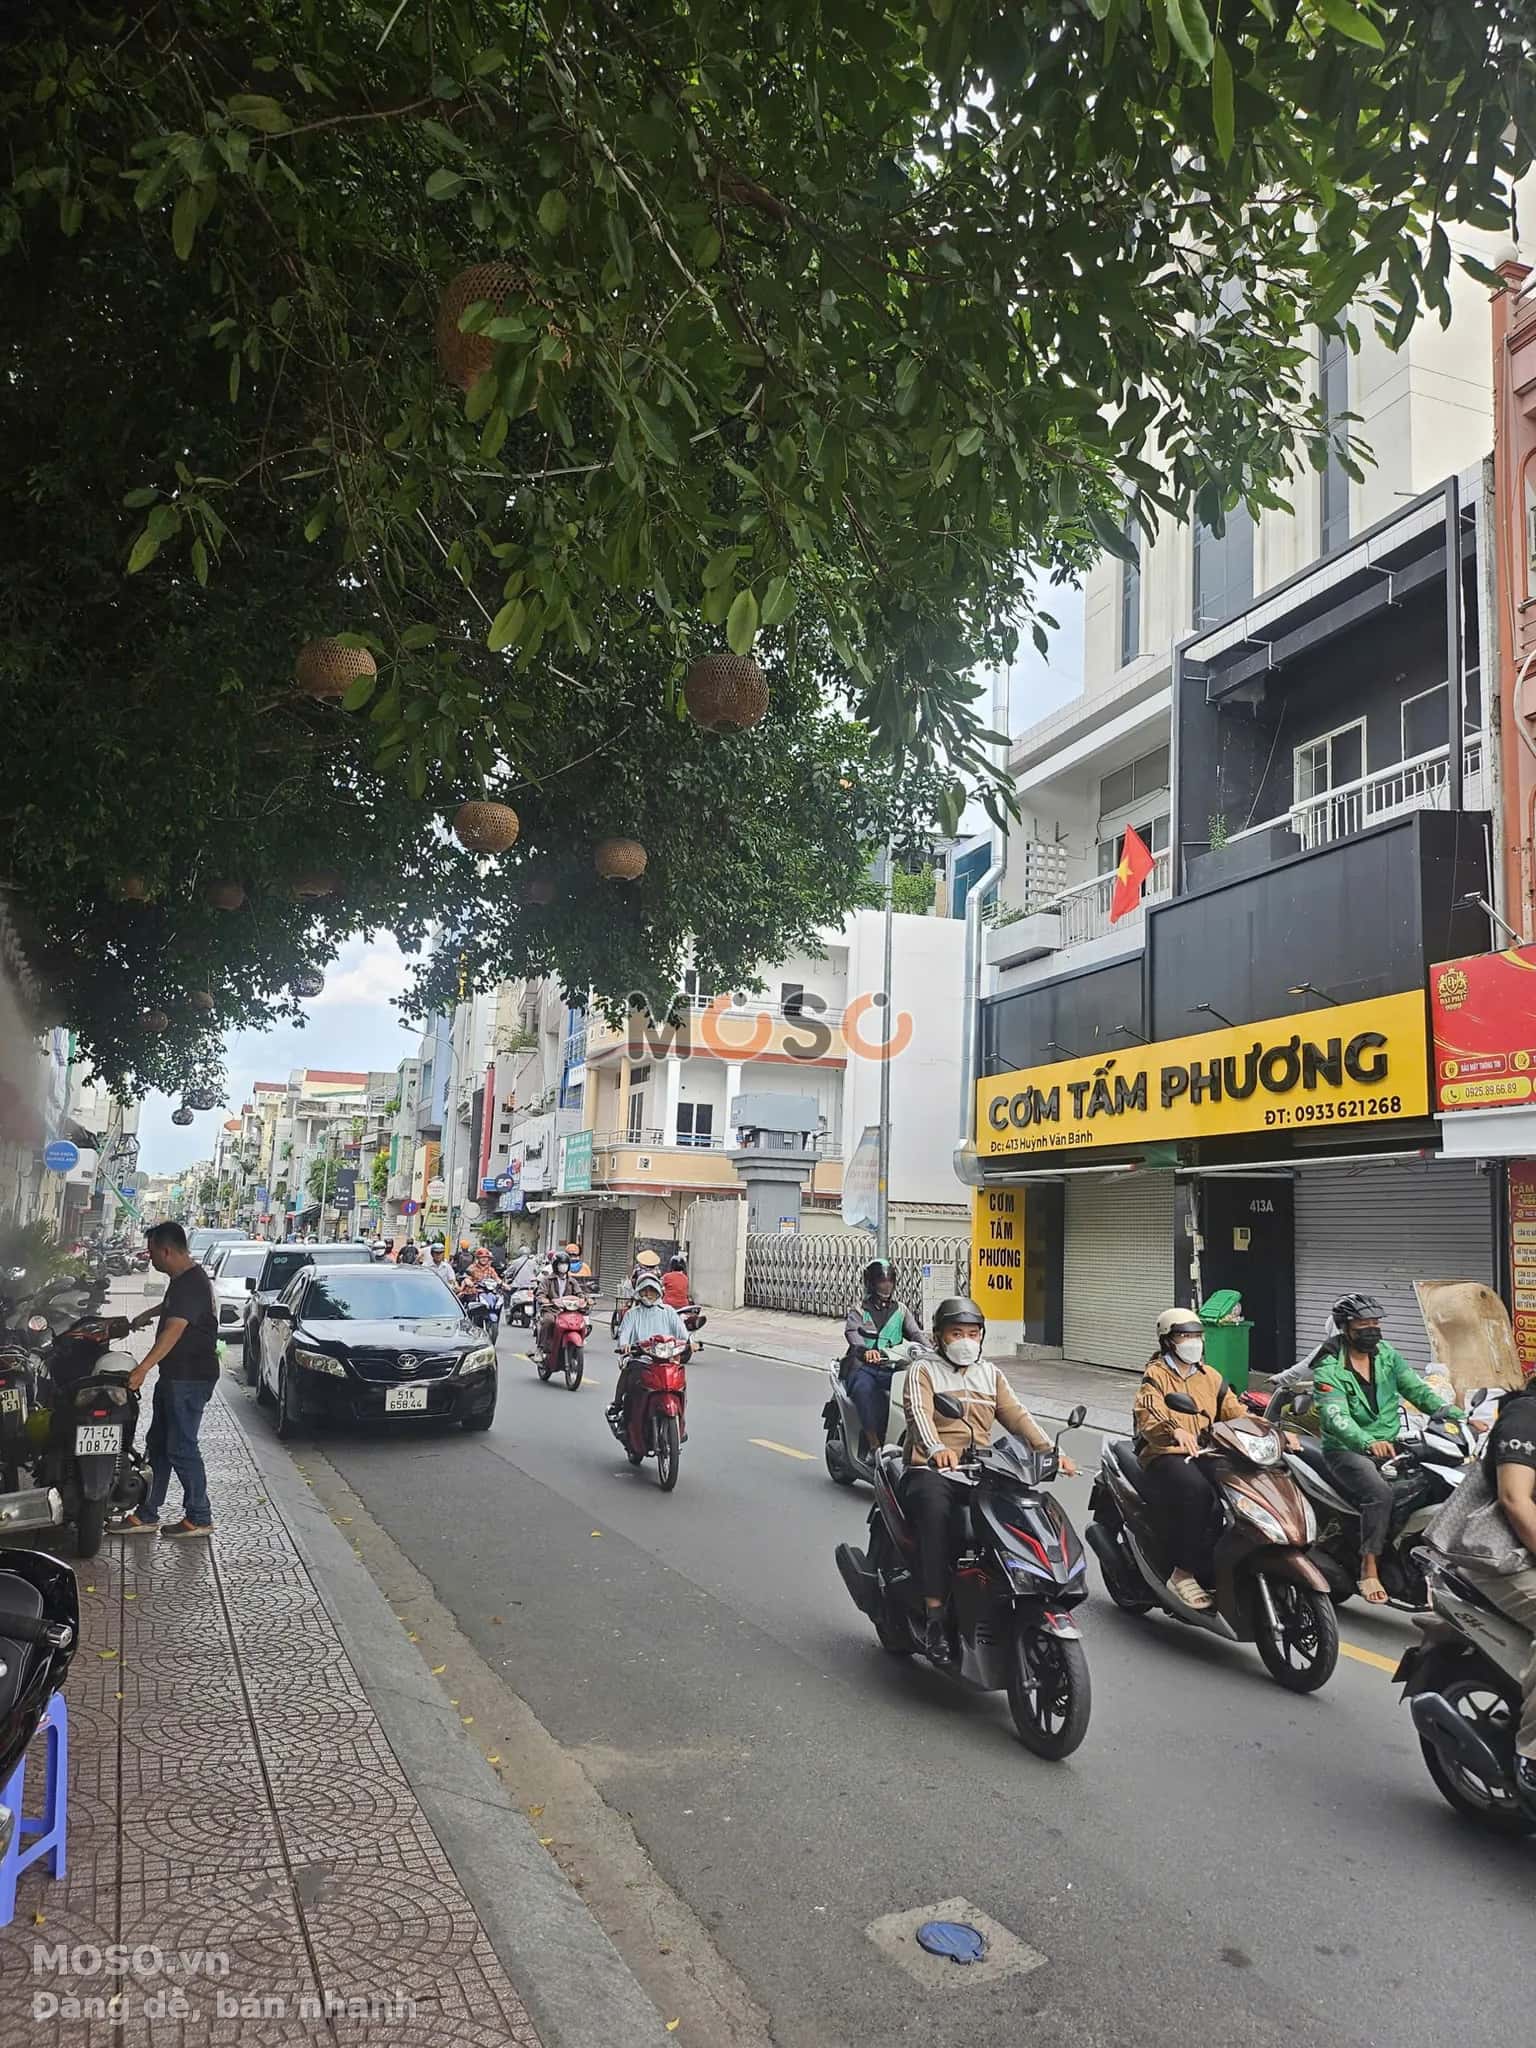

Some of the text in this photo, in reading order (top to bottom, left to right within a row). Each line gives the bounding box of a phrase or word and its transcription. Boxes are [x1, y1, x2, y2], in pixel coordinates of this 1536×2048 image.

[988, 1031, 1388, 1129] CƠM TẤM PHƯƠNG
[1264, 1108, 1290, 1125] ĐT:
[1006, 1139, 1018, 1151] 413
[990, 1192, 1014, 1212] CƠM
[1250, 1200, 1274, 1212] 413A
[979, 1247, 1020, 1267] PHƯƠNG
[988, 1274, 1012, 1290] 40k
[398, 1391, 415, 1400] 51K
[390, 1400, 422, 1409] 658.44
[83, 1427, 114, 1439] 71-C4
[79, 1440, 118, 1453] 108.72
